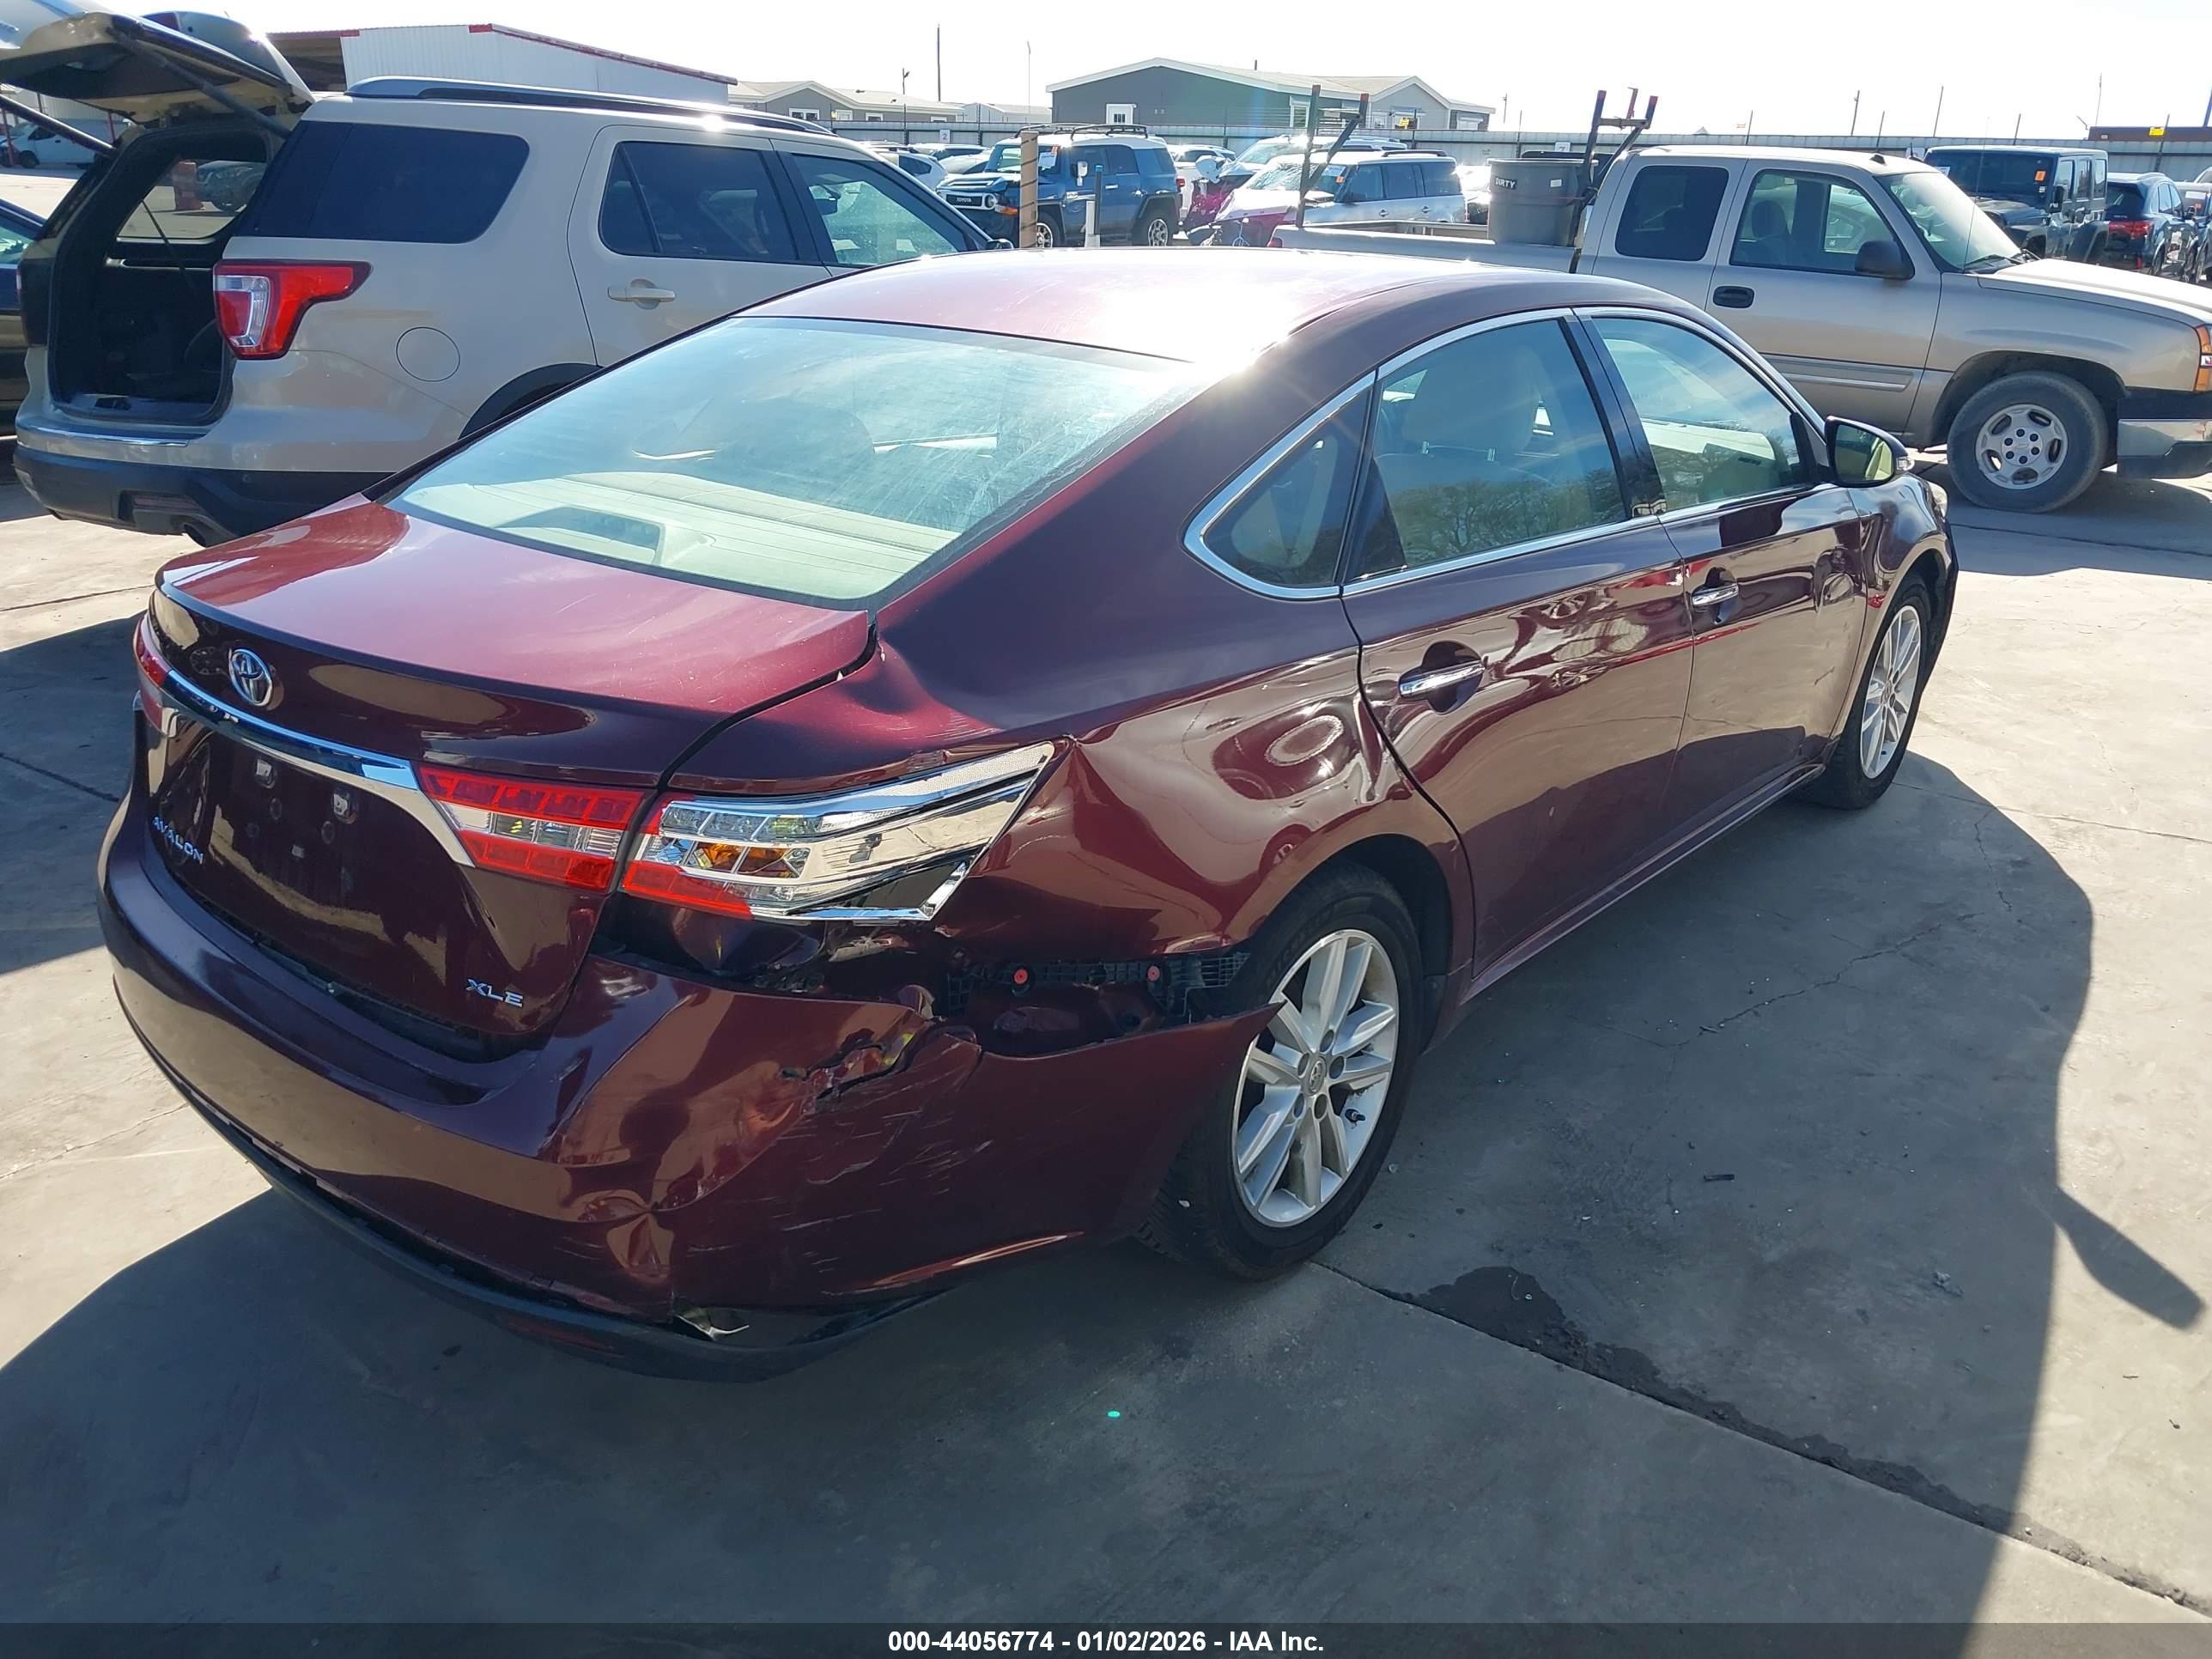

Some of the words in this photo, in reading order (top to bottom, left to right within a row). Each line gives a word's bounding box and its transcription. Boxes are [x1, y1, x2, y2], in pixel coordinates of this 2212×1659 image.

[1495, 177, 1516, 189] DIRTY
[153, 817, 204, 865] AVALON
[465, 978, 524, 1008] XLE
